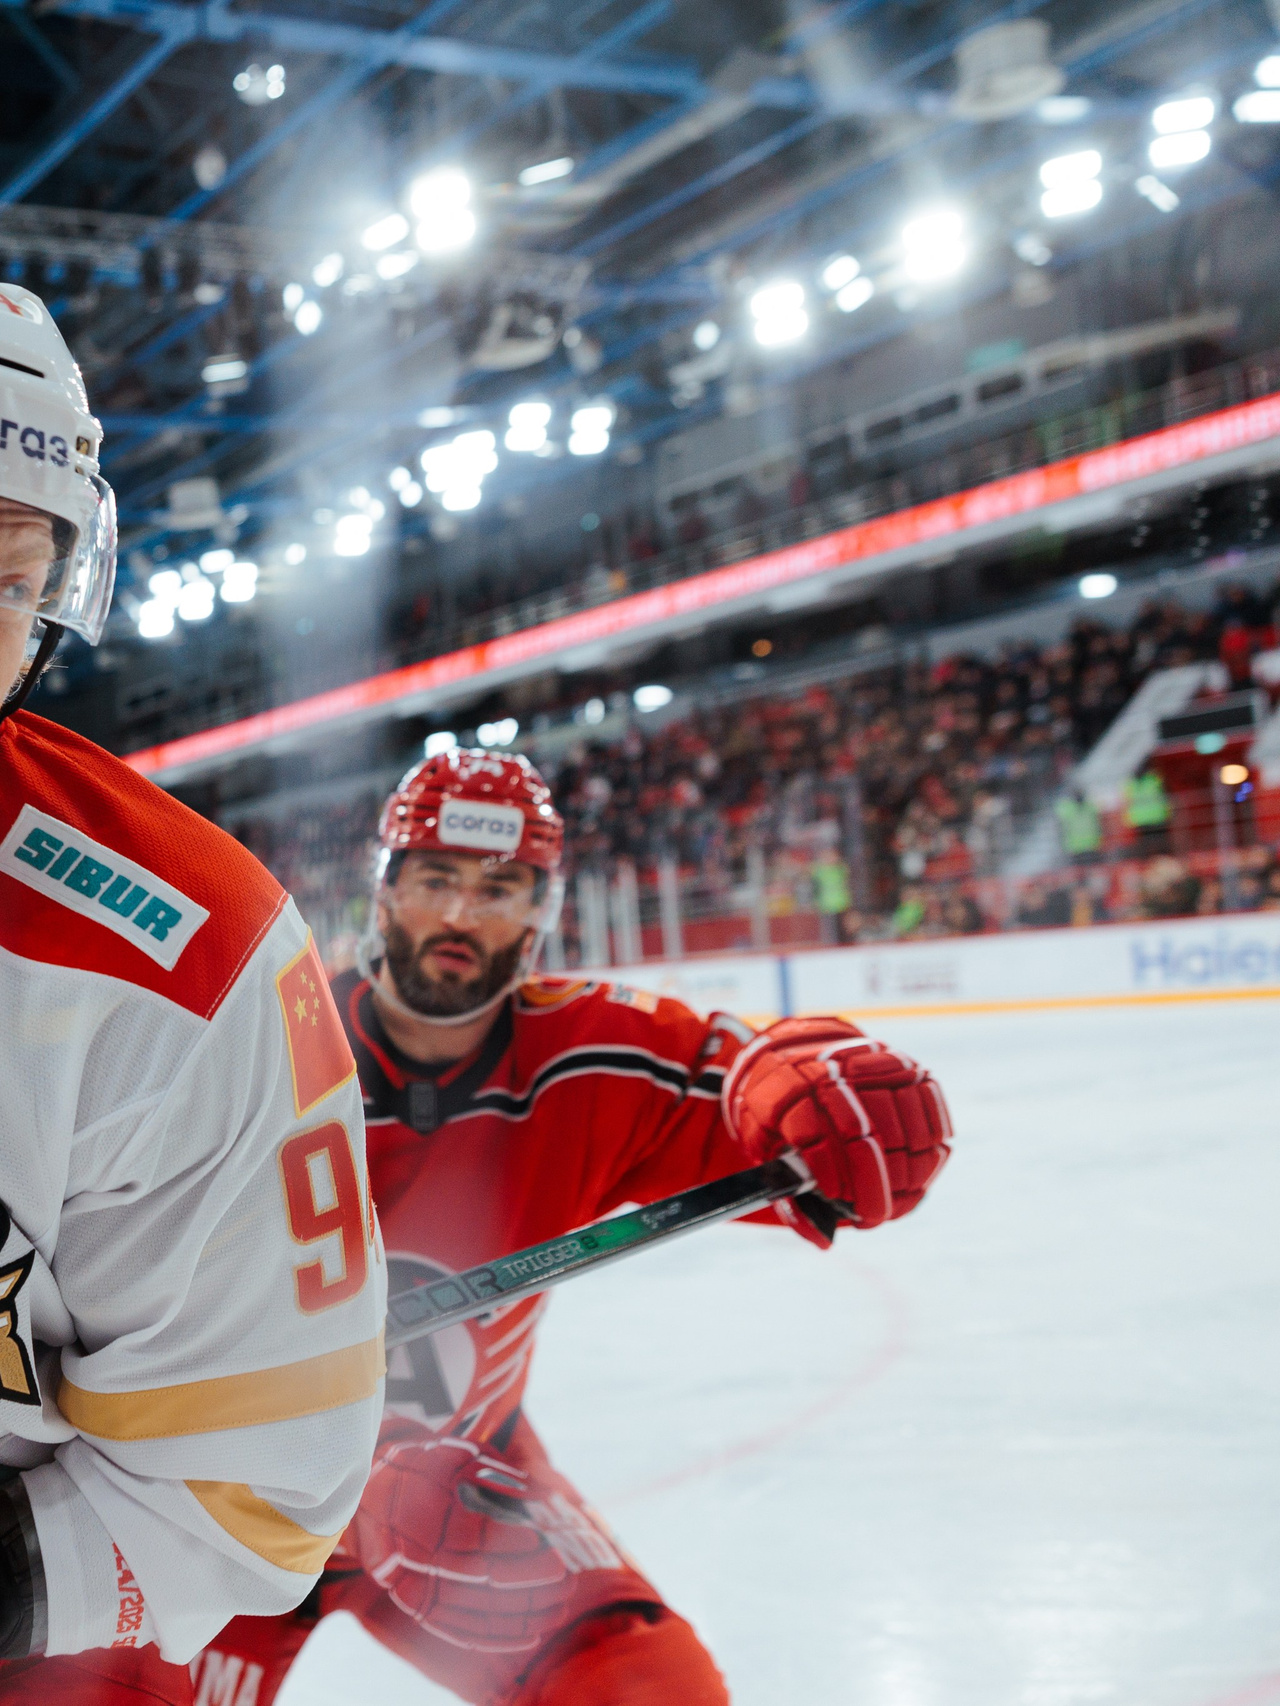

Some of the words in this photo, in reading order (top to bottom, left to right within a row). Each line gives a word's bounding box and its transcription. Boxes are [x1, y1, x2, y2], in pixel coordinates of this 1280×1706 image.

[13, 827, 183, 943] SIBUR
[1130, 927, 1280, 986] Haie
[277, 1117, 376, 1317] 9
[384, 1266, 506, 1329] COR
[502, 1238, 584, 1280] TRIGGER
